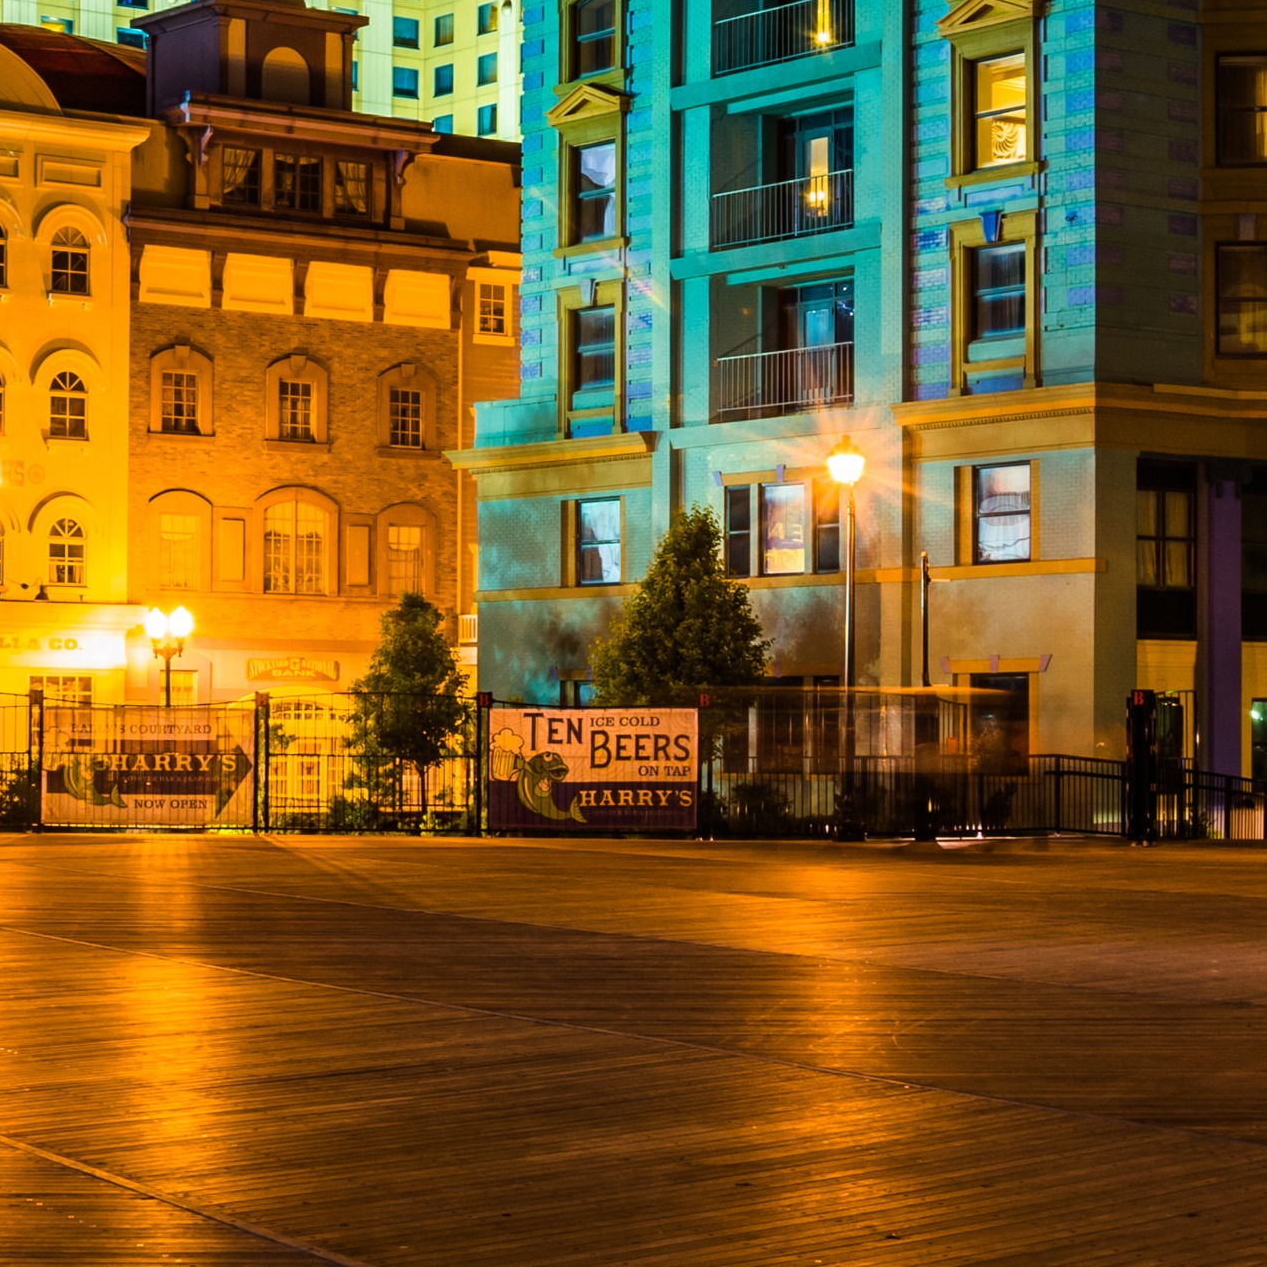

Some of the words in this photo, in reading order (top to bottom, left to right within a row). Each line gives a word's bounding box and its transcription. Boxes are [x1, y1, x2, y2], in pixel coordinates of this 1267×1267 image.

[272, 669, 316, 677] BANK
[479, 694, 489, 706] B
[700, 694, 710, 707] B
[1134, 691, 1144, 705] B
[129, 724, 211, 734] COURTYARD
[523, 712, 583, 751] TEN
[590, 717, 615, 727] ICE
[619, 716, 660, 727] COLD
[590, 730, 691, 769] BEERS
[109, 754, 237, 772] HARRY'S
[638, 765, 659, 777] ON
[664, 765, 691, 777] TAP
[134, 799, 165, 809] NOW
[170, 799, 207, 809] OPEN
[579, 789, 693, 807] HARRY'S
